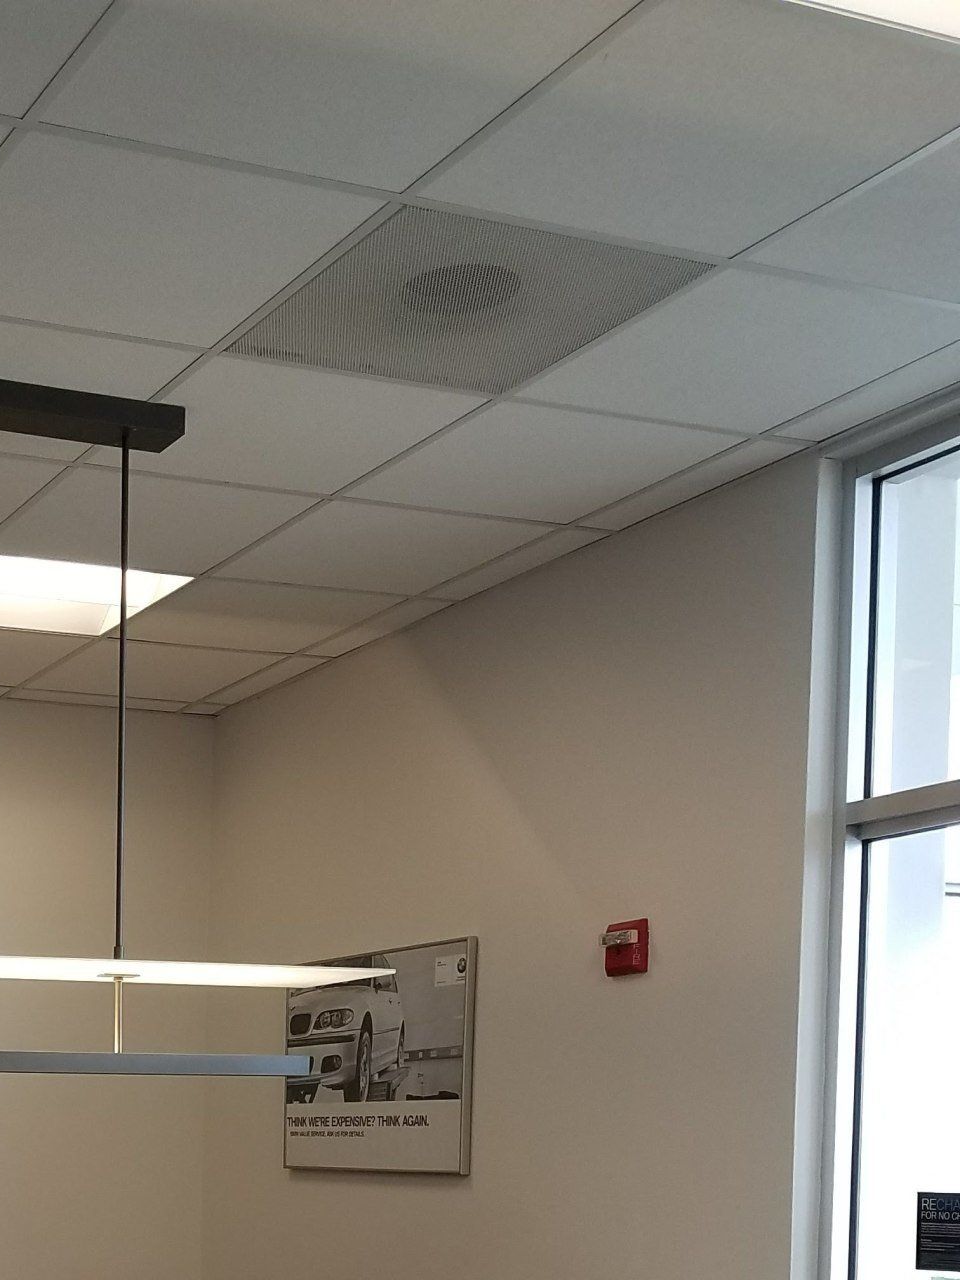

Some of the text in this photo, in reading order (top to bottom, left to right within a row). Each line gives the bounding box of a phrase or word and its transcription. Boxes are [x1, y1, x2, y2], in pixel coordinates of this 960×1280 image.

[287, 1115, 430, 1128] THINK WE'RE EXPENSIVE? THINK AGAIN.
[921, 1211, 937, 1220] FOR
[938, 1211, 951, 1221] NO
